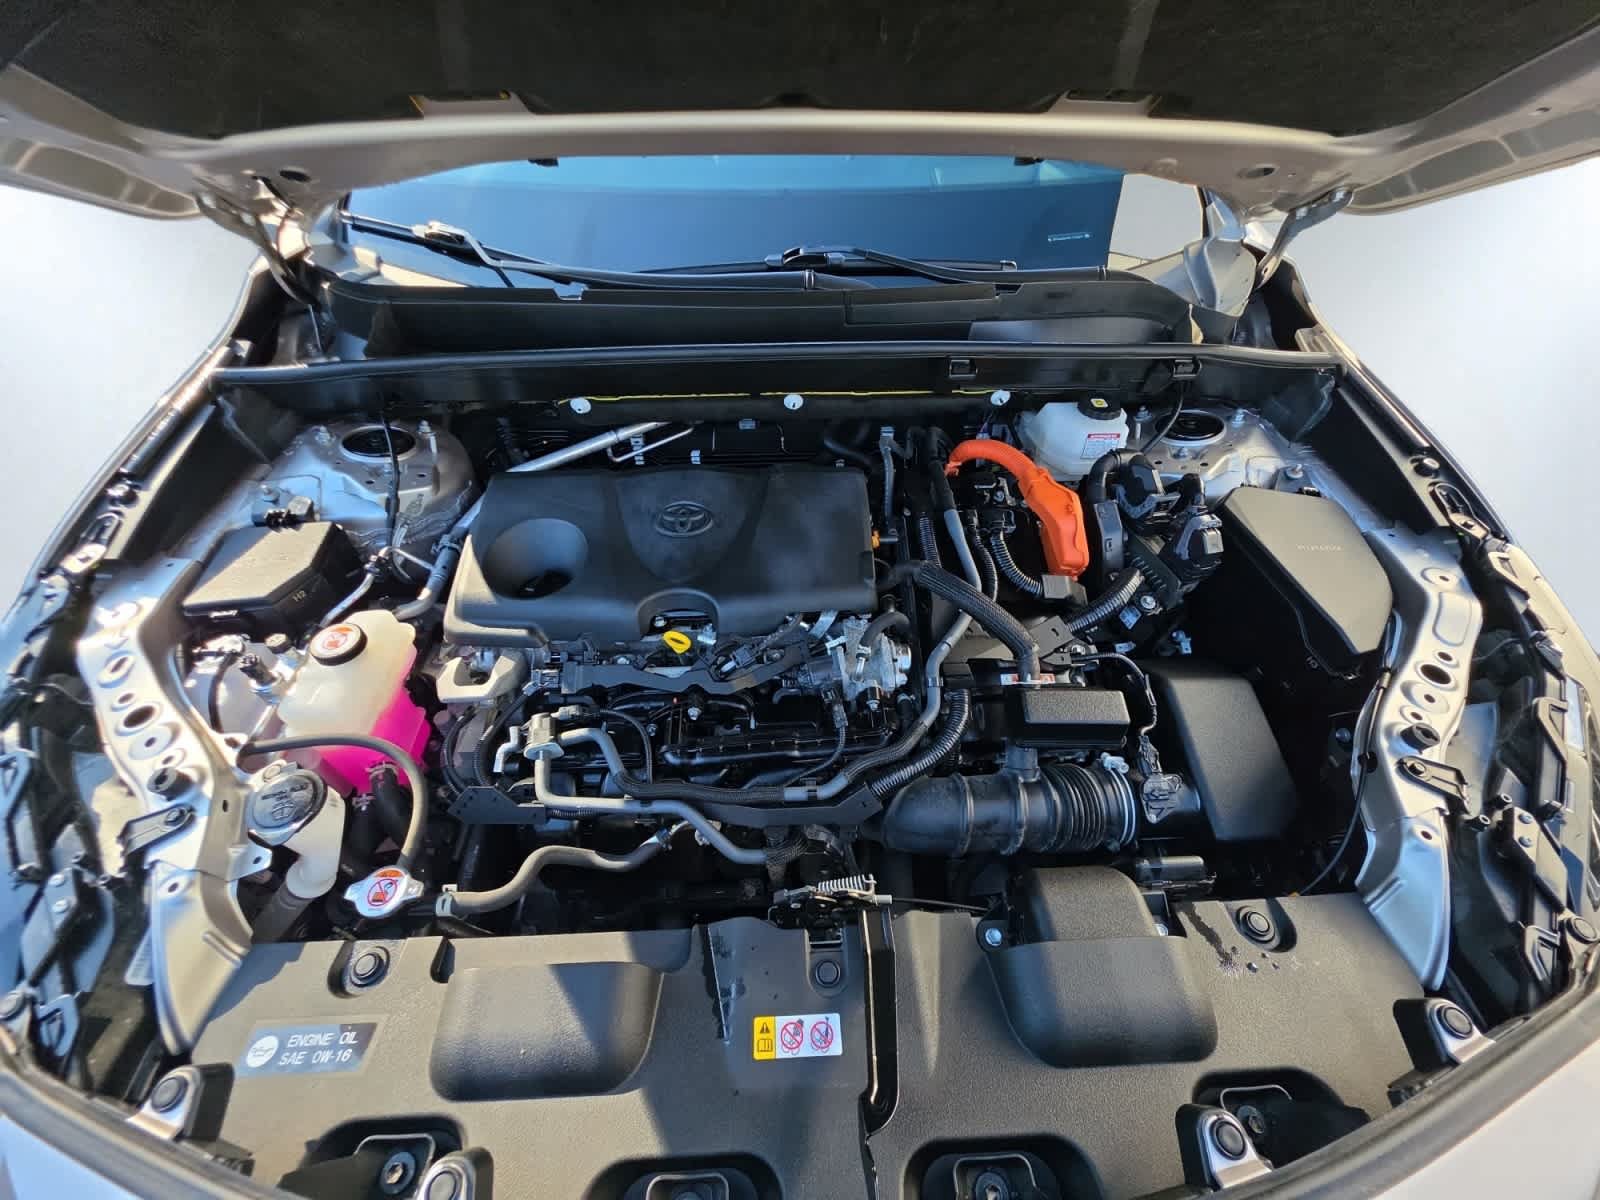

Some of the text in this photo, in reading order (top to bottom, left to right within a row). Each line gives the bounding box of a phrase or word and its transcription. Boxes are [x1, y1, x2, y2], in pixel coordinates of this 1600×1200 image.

[286, 1031, 358, 1047] ENGINE OIL
[278, 1051, 308, 1066] SAE
[311, 1048, 353, 1064] 0W-16
